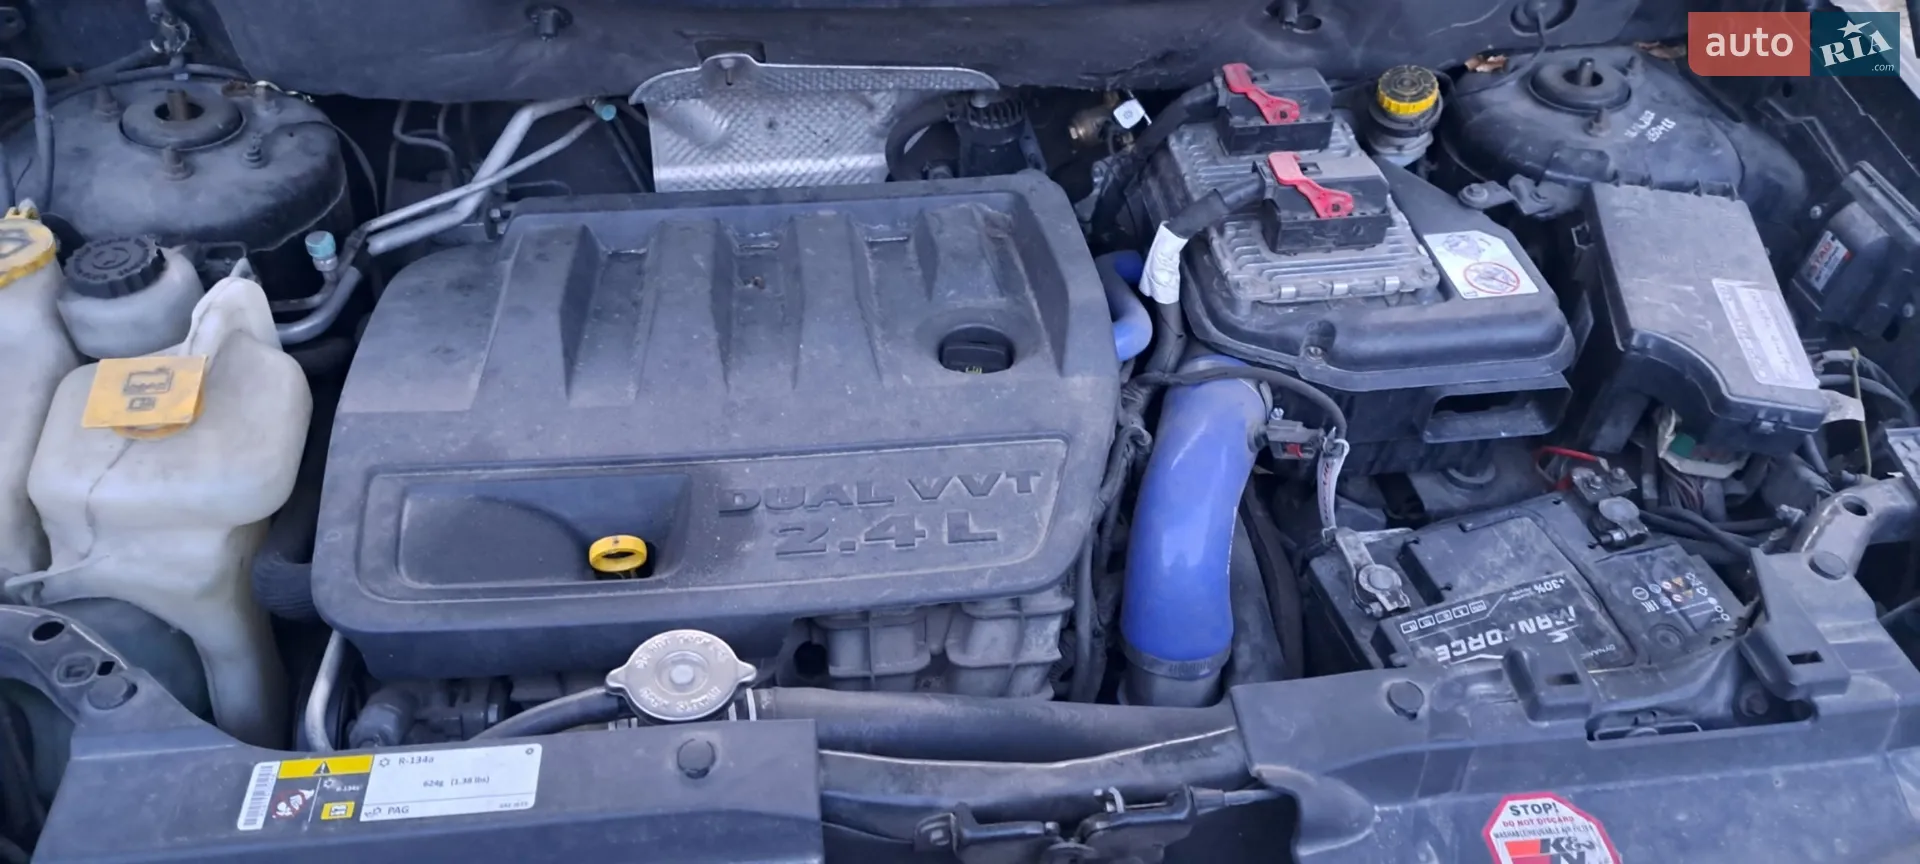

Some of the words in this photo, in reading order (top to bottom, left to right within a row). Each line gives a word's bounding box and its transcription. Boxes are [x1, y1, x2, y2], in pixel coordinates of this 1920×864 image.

[718, 480, 896, 518] DUAL
[906, 471, 1042, 501] VVT
[398, 755, 435, 765] R-134a
[387, 805, 410, 816] PAG
[1509, 802, 1560, 816] STOP!
[1502, 820, 1515, 828] DO
[1517, 818, 1535, 827] NOT
[1537, 815, 1575, 826] DISCARD
